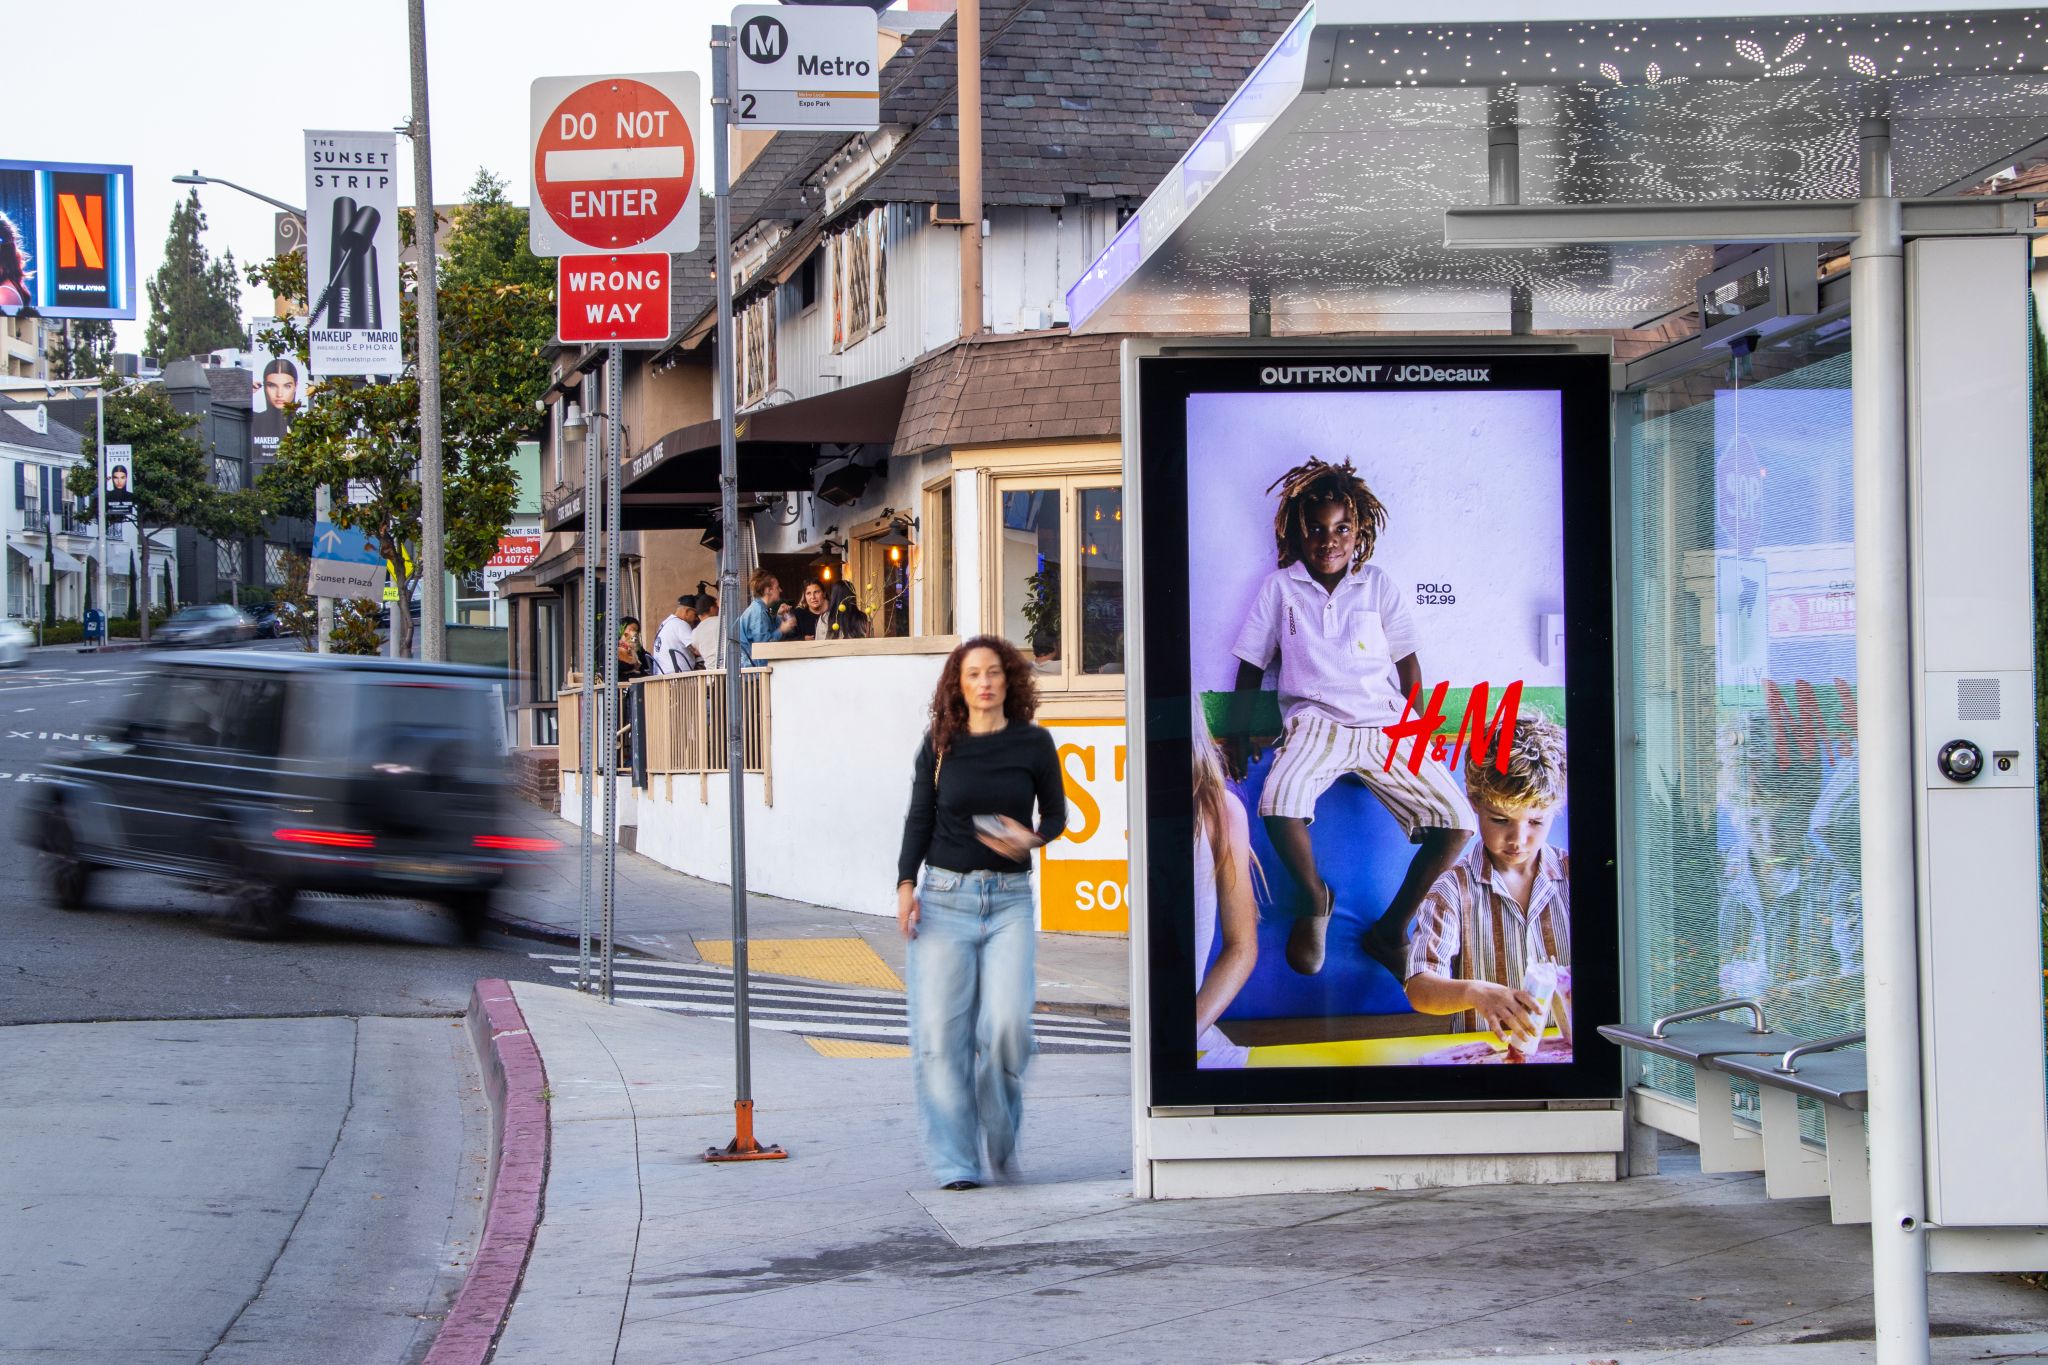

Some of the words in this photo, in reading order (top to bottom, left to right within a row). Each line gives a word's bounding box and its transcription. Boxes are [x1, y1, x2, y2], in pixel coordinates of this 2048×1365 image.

[749, 24, 780, 56] M
[797, 54, 870, 77] Metro
[741, 94, 757, 119] 2
[560, 112, 597, 141] DO
[616, 110, 670, 139] NOT
[313, 139, 334, 147] THE
[313, 151, 389, 165] SUNSET
[314, 174, 389, 189] STRIP
[570, 188, 658, 219] ENTER
[58, 193, 104, 270] N
[58, 283, 76, 291] NOW
[76, 284, 106, 292] PLAYING
[568, 270, 661, 292] WRONG
[585, 303, 643, 324] WAY
[312, 331, 352, 343] MAKEUP
[367, 331, 399, 343] MARIO
[346, 343, 394, 351] SEPHORA
[1261, 366, 1382, 384] OUTFRONT
[1394, 365, 1491, 383] JCDecaux
[254, 436, 280, 444] MAKEUP
[504, 545, 533, 554] Lease
[505, 556, 522, 564] 407
[315, 573, 346, 584] Sunset
[347, 577, 373, 588] Plaza
[487, 570, 502, 580] Jay
[383, 589, 400, 598] AHE
[1416, 583, 1453, 593] POLO
[1416, 594, 1456, 606] $12.99
[1381, 679, 1524, 777] H&M
[1075, 880, 1129, 912] SO
